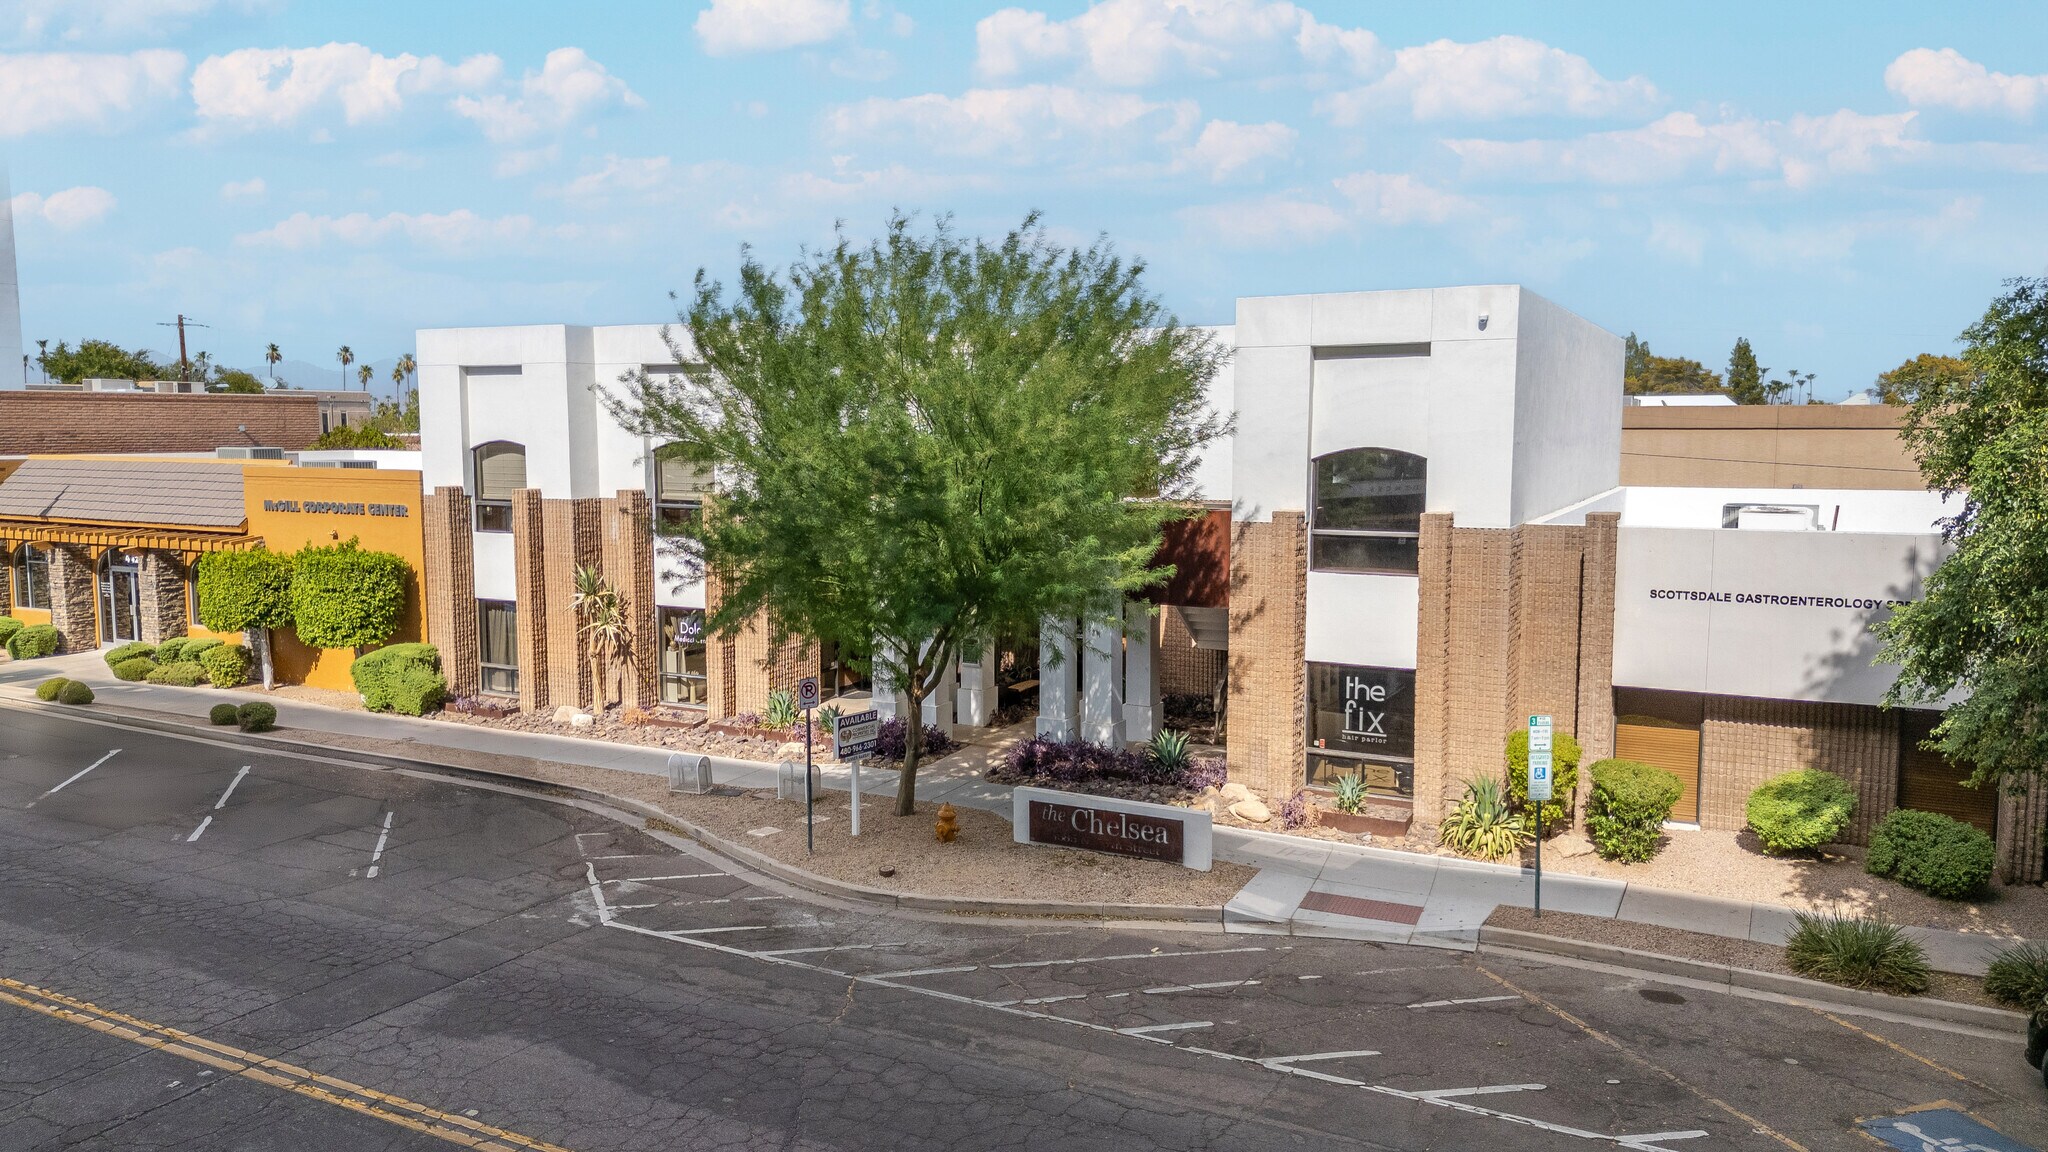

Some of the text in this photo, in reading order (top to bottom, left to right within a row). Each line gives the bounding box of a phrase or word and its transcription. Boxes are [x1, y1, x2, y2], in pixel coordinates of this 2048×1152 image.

[302, 501, 366, 516] CORPORATE
[367, 503, 409, 517] CENTER
[1649, 589, 1732, 603] SCOTTSDALE
[1735, 593, 1883, 610] GASTROENTEROLOGY
[1345, 675, 1386, 702] the
[839, 711, 877, 727] AVAILABLE
[1344, 700, 1385, 733] fix
[1531, 717, 1536, 726] 3
[839, 740, 877, 755] 480-966-2301
[1361, 736, 1387, 744] parlor
[1042, 804, 1066, 822] the
[1071, 809, 1169, 845] Chelsea
